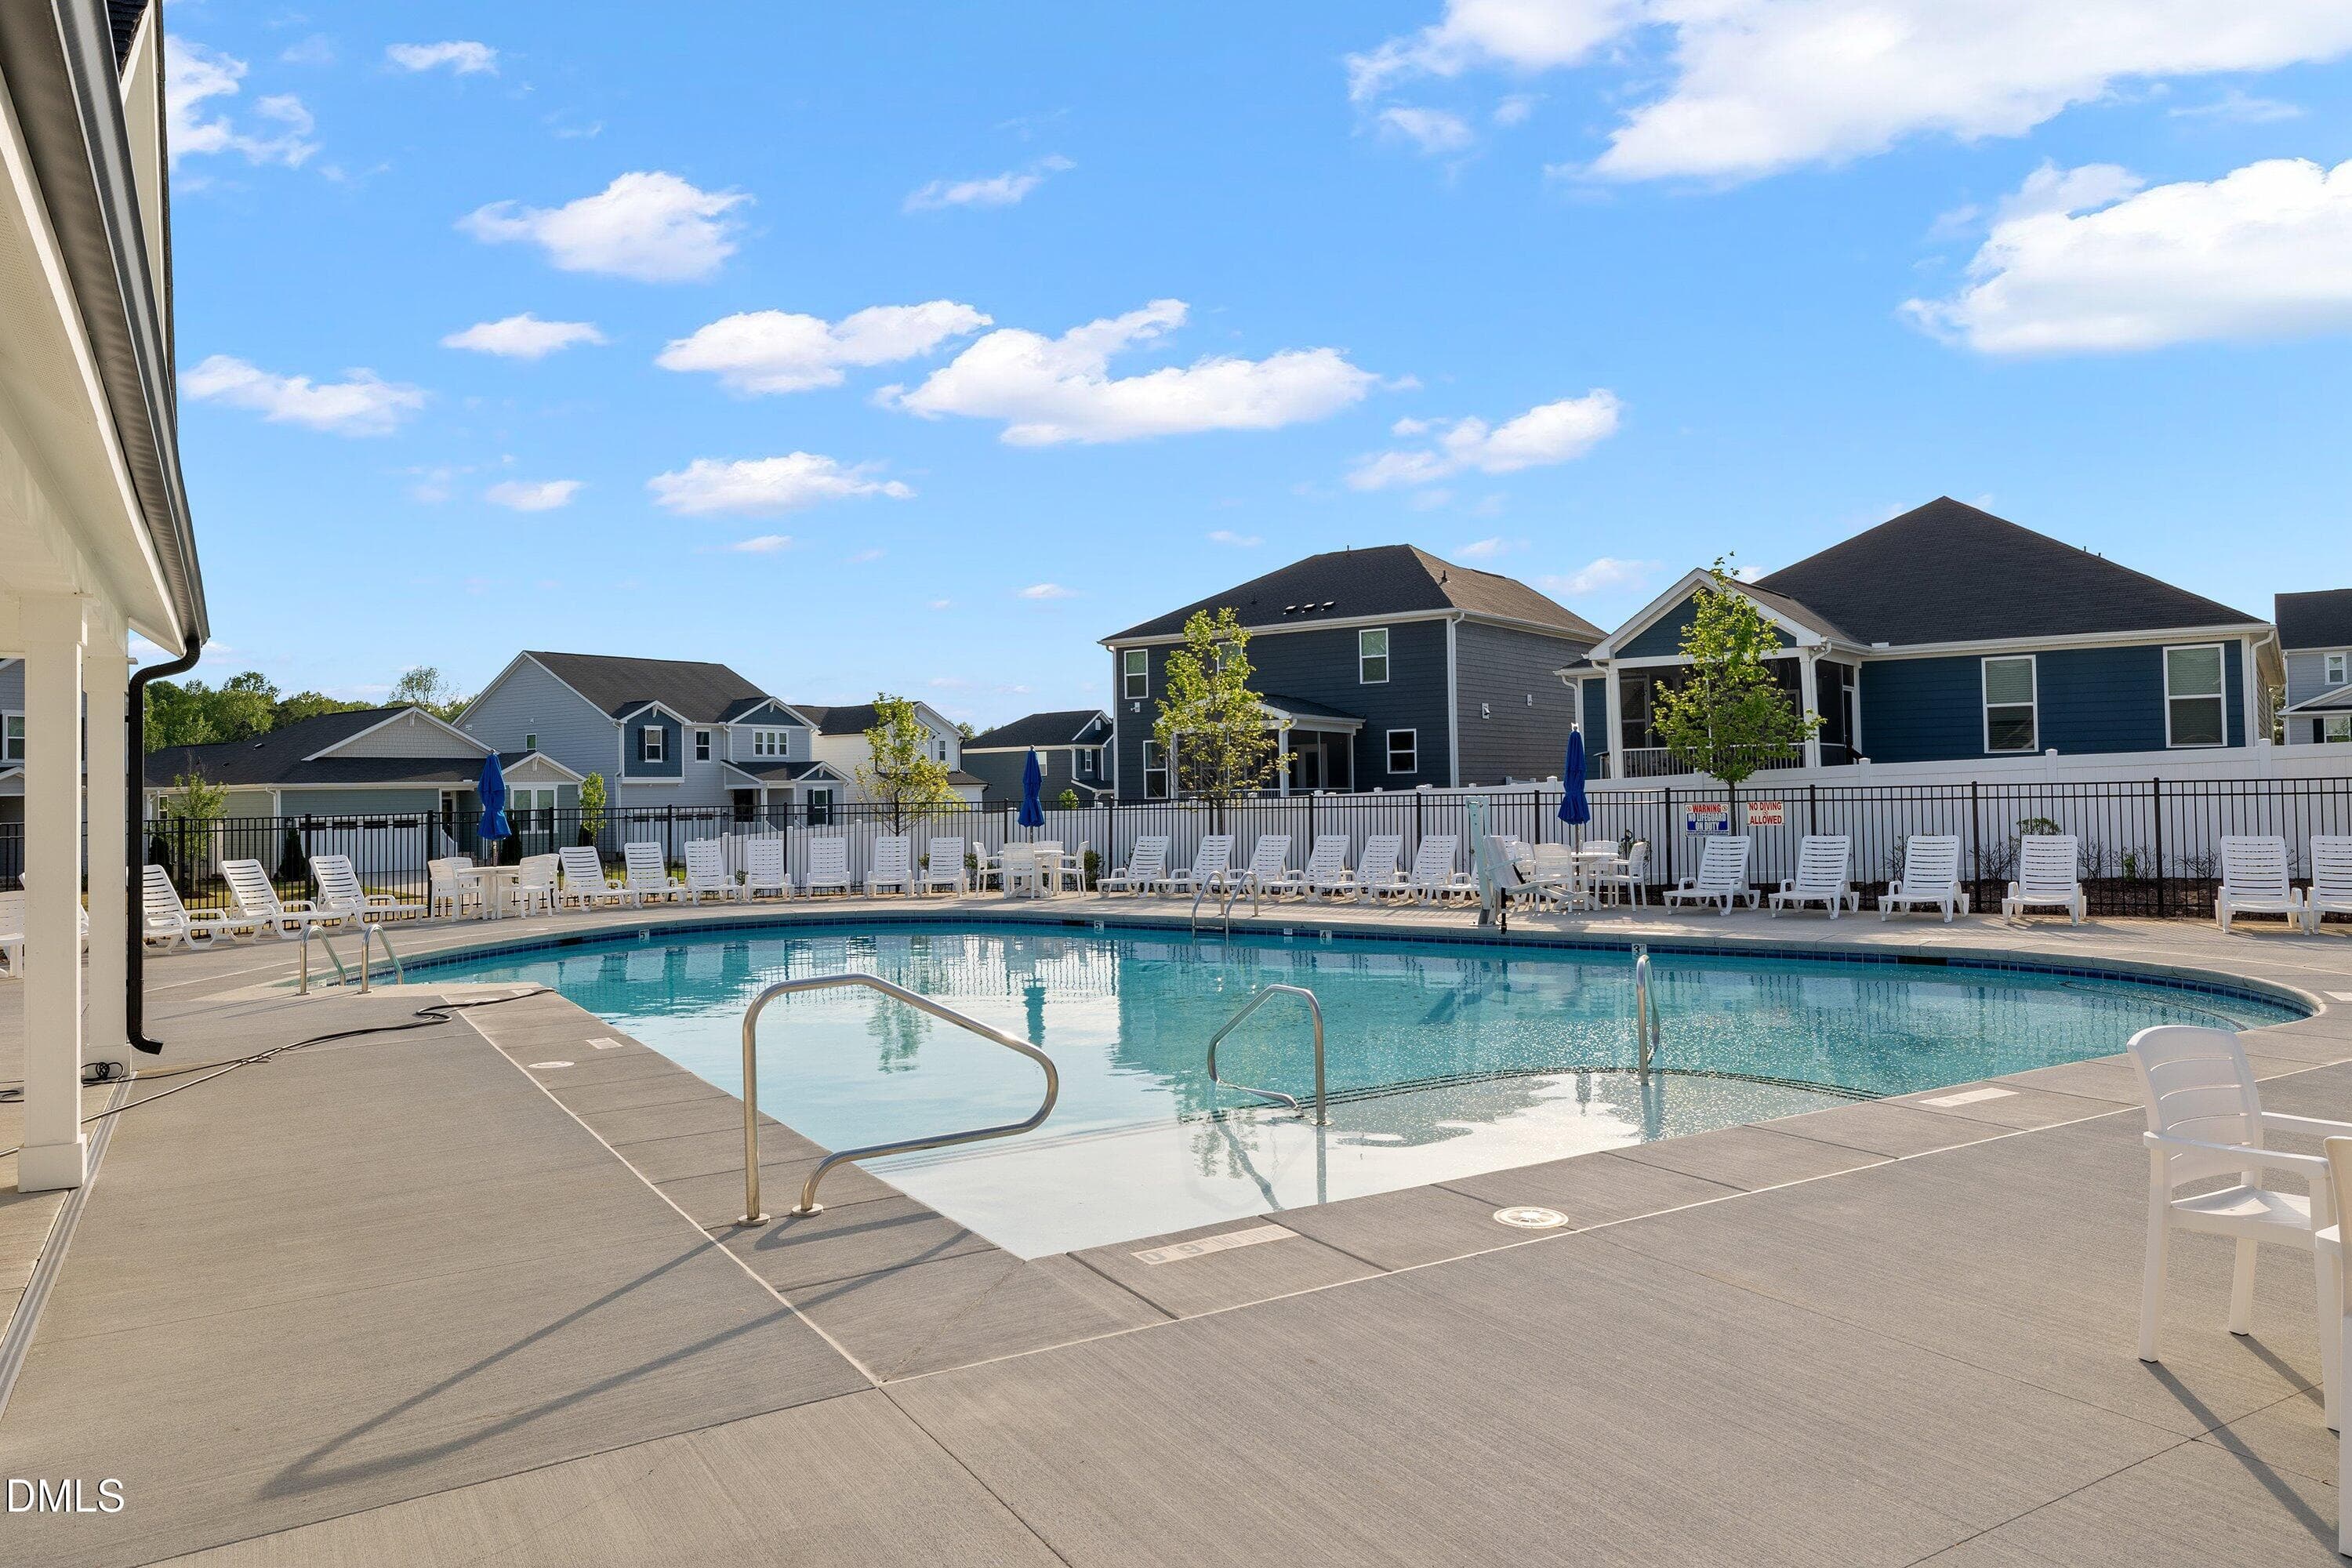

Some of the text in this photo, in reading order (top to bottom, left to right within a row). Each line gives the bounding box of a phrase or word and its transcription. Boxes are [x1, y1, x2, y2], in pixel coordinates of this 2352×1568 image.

[1692, 804, 1722, 813] WARNING
[1748, 802, 1782, 811] NO DIVING
[1688, 813, 1726, 822] NO LIFEGUARD
[1750, 815, 1782, 824] ALLOWED
